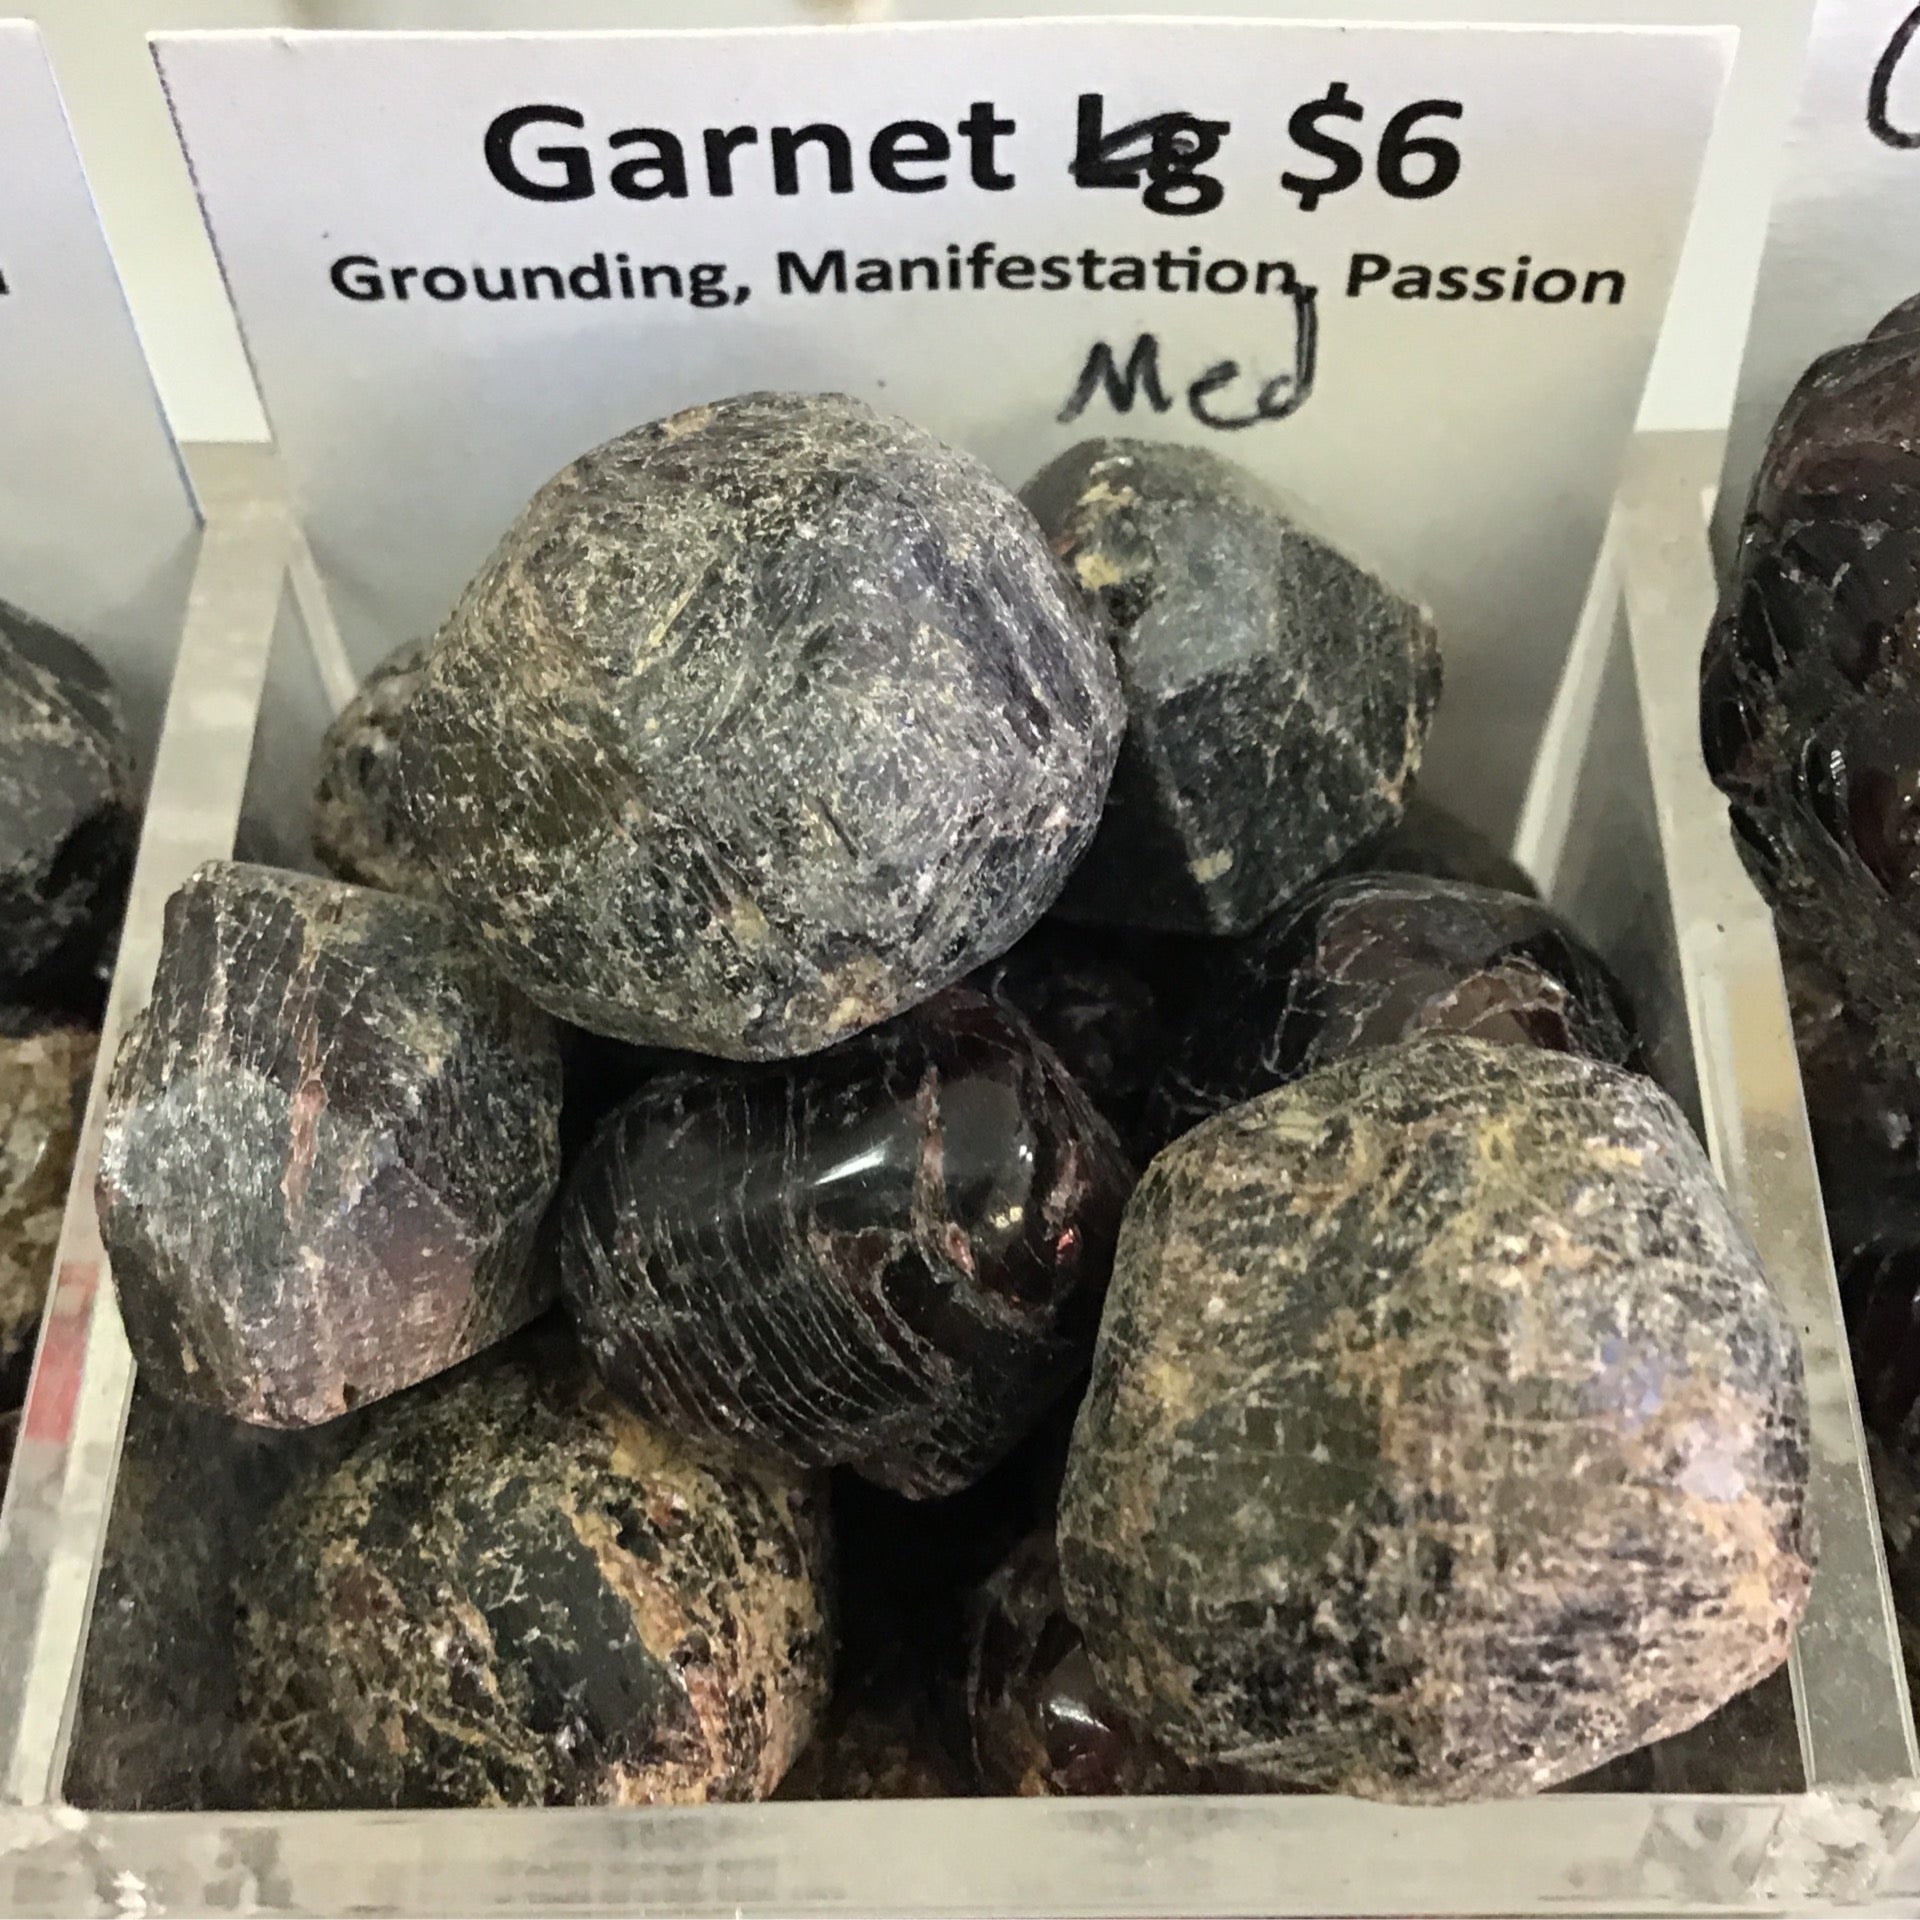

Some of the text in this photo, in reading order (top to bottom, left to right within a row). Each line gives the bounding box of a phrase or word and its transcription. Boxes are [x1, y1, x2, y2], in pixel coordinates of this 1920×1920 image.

[483, 101, 1016, 203] Garnet
[1280, 81, 1463, 212] $6
[330, 252, 751, 309] Grounding,
[1346, 253, 1626, 305] Passion
[1057, 283, 1318, 431] Med
